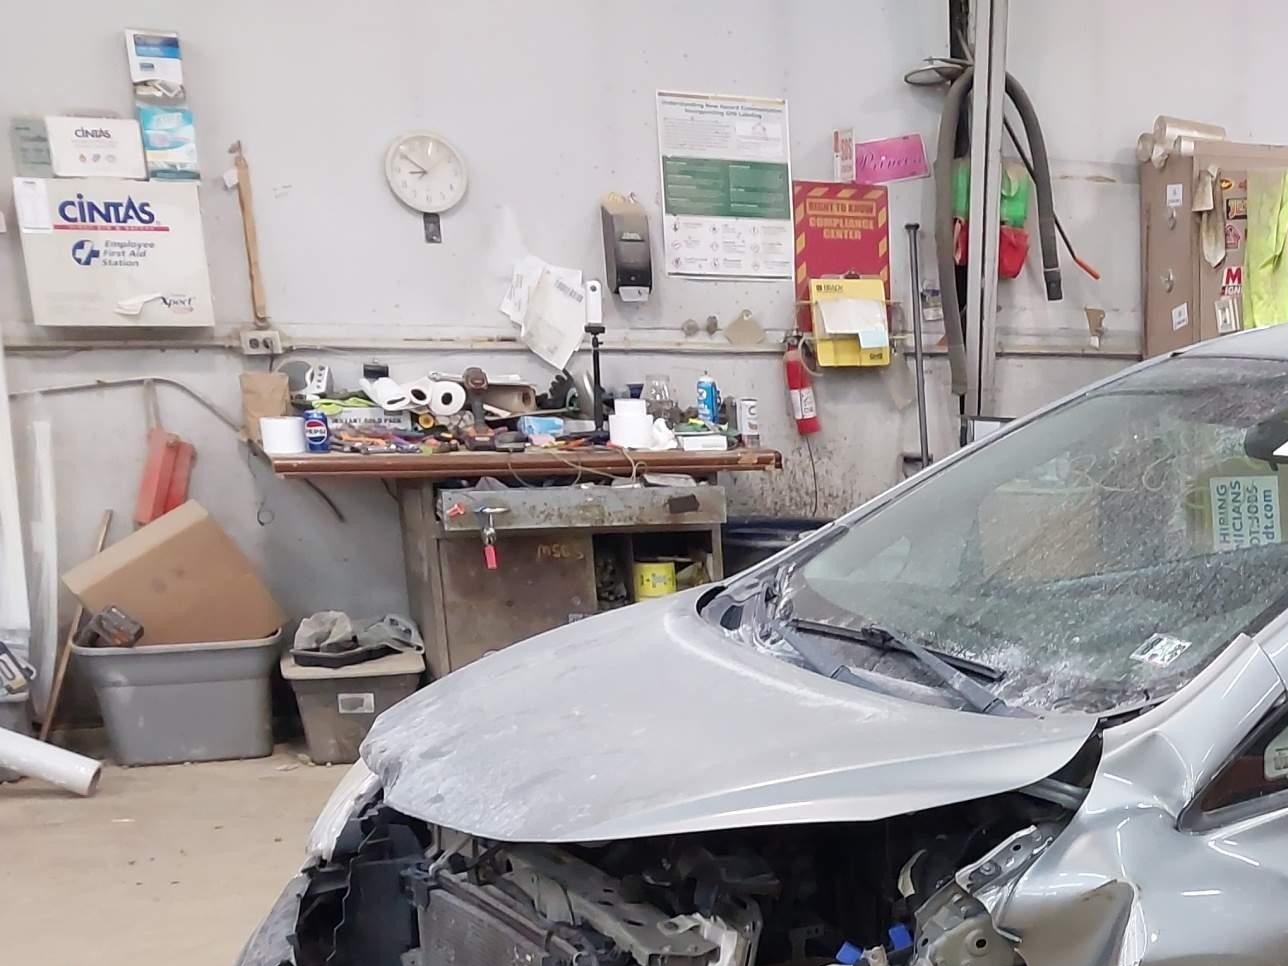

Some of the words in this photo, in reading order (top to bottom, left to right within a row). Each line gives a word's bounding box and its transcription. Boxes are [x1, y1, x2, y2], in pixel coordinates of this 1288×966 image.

[74, 126, 112, 139] CINTAS
[58, 192, 155, 225] CINTAS
[808, 217, 875, 229] COMPLIANCE
[823, 228, 862, 240] CENTER
[104, 240, 155, 249] Employee
[102, 249, 126, 257] First
[129, 249, 147, 257] Aid
[101, 259, 140, 267] Station
[1216, 484, 1231, 544] HIRING
